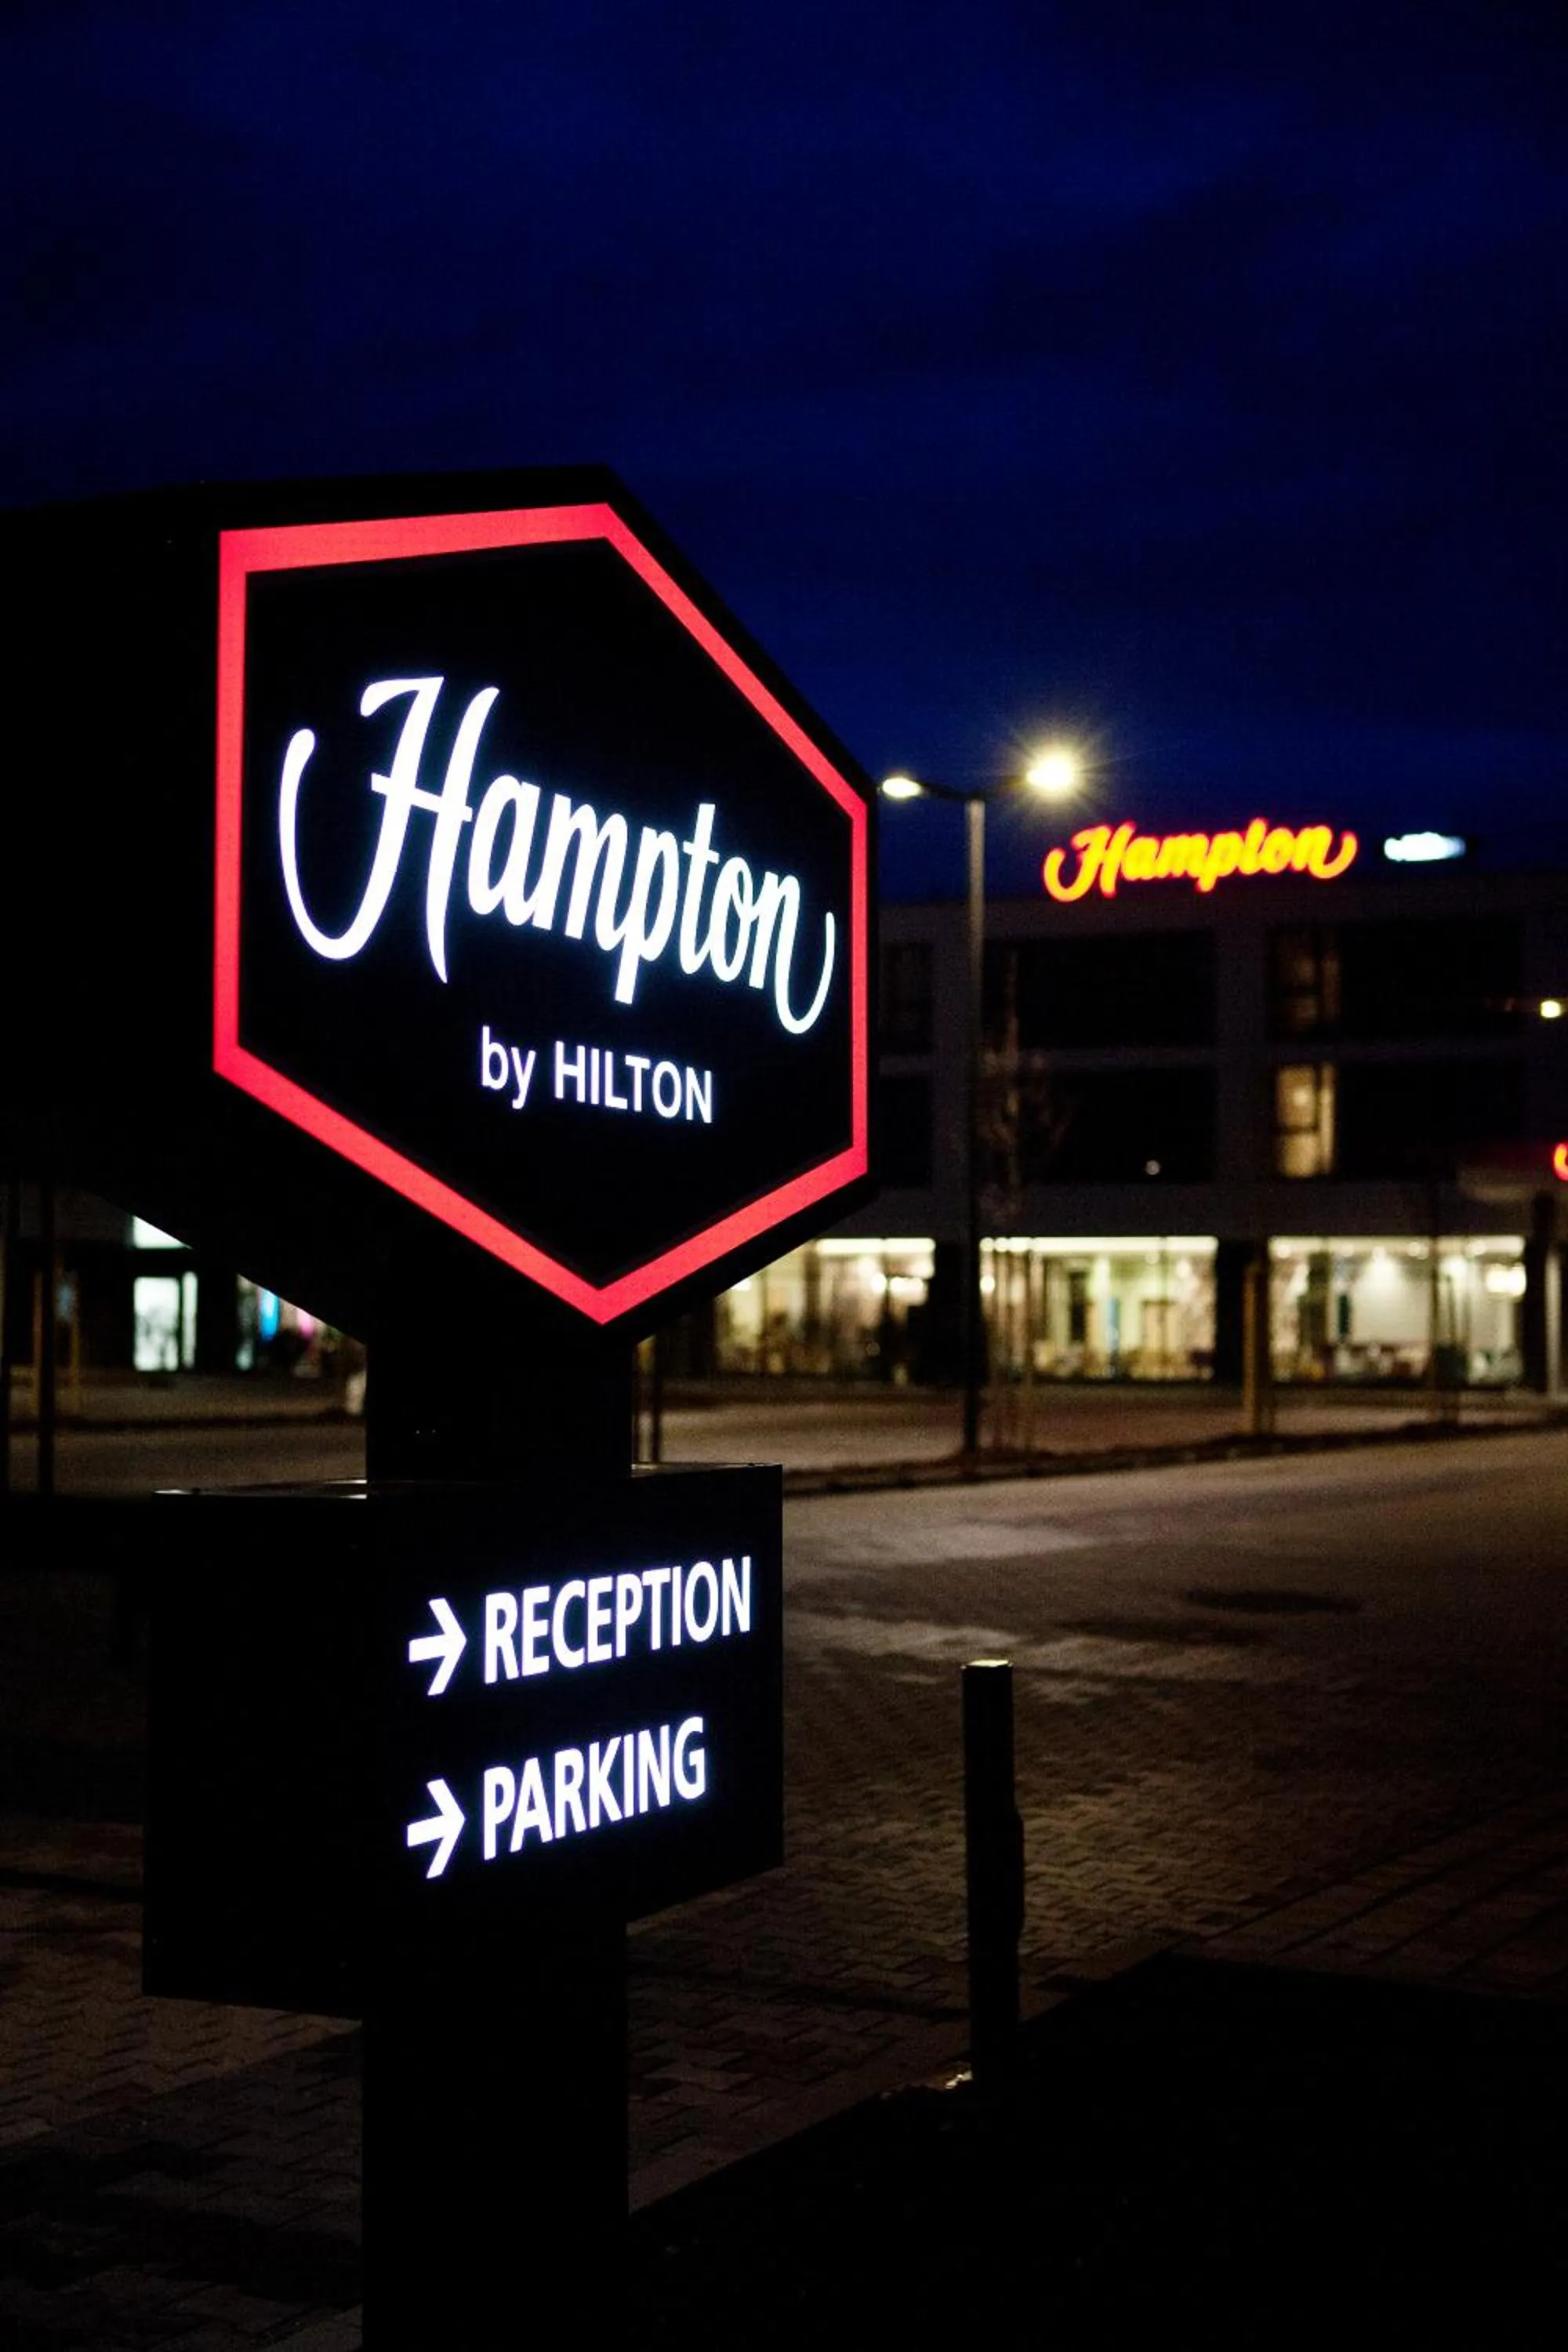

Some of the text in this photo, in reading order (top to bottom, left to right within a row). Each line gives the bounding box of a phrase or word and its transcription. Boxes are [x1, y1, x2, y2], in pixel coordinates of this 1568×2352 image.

[278, 675, 836, 1035] Hampton
[481, 1025, 713, 1124] by HILTON
[483, 1555, 752, 1685] RECEPTION
[482, 1715, 706, 1861] PARKING
